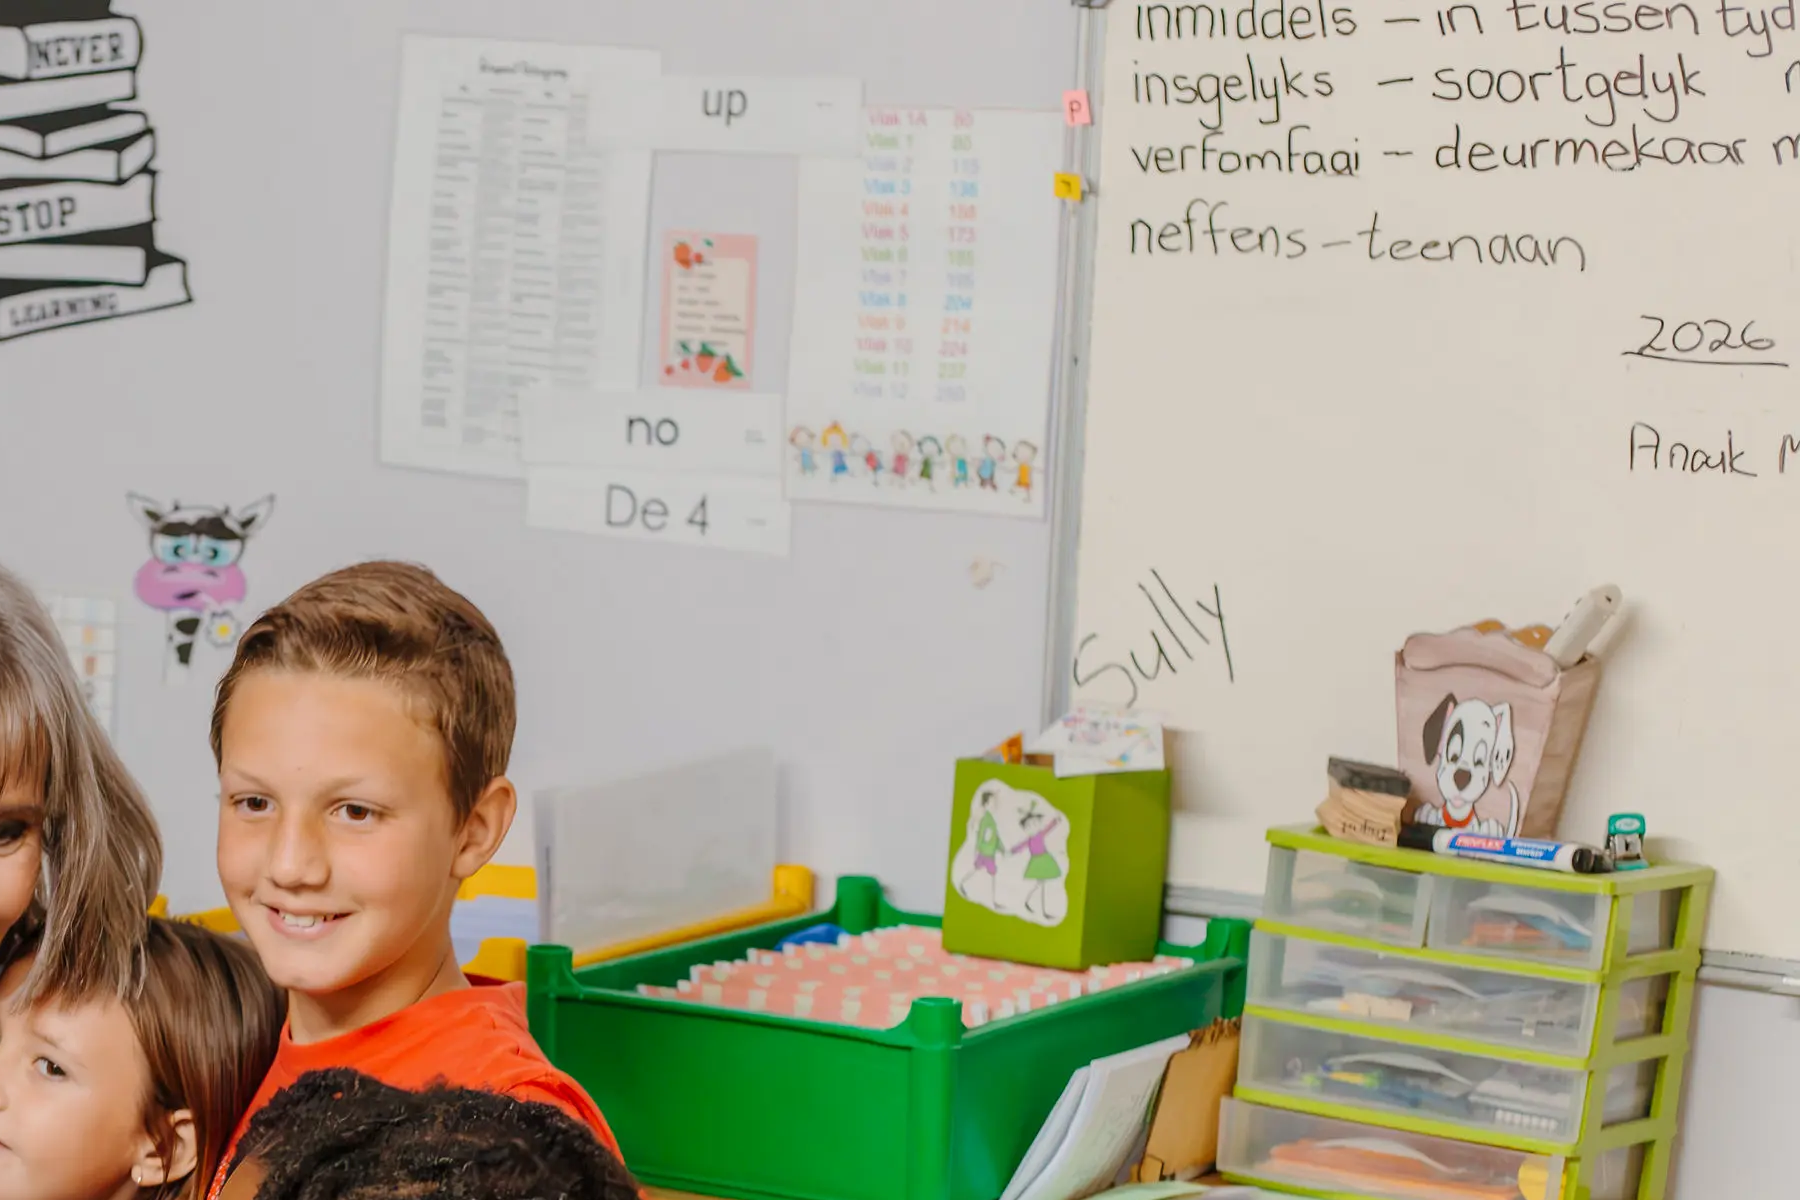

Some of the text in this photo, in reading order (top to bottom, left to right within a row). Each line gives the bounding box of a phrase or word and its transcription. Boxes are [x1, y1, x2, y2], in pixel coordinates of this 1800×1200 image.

[31, 32, 125, 70] NEVER
[1136, 0, 1358, 42] inmiddels
[1436, 3, 1485, 36] in
[1505, 0, 1701, 36] tussen
[1714, 0, 1797, 62] tyd
[701, 84, 749, 128] up
[1133, 53, 1335, 130] insgelyks
[1434, 122, 1748, 172] deurmekaar
[1129, 198, 1308, 259] neffens
[1357, 210, 1587, 273] teenaan
[10, 292, 119, 329] LEARNING
[1637, 314, 1776, 356] 2026
[625, 414, 680, 447] no
[605, 483, 709, 537] De 4
[1072, 568, 1236, 708] Sully
